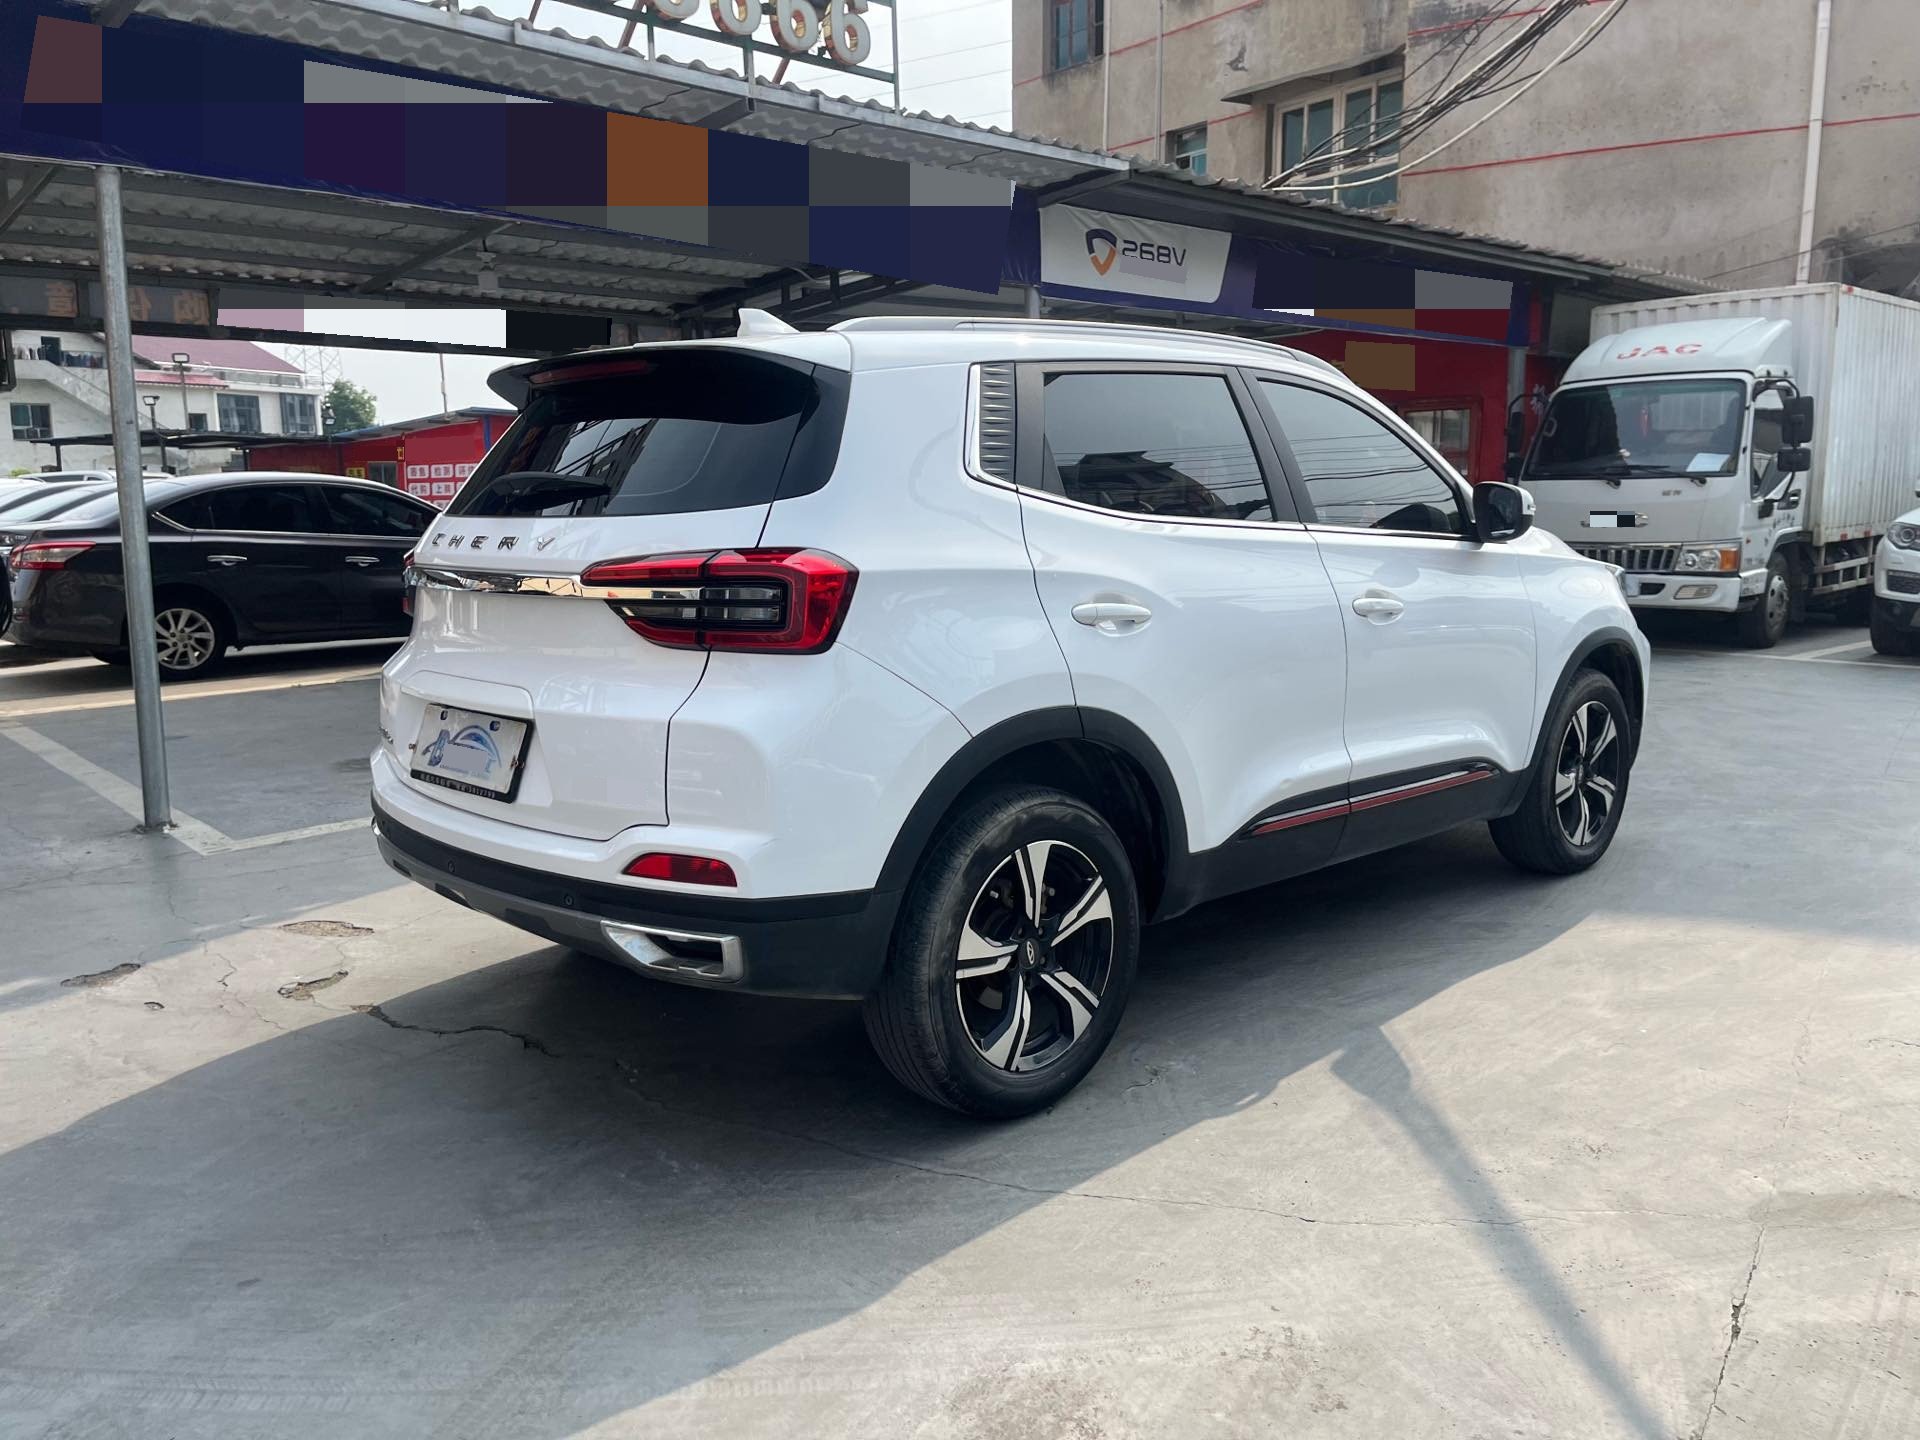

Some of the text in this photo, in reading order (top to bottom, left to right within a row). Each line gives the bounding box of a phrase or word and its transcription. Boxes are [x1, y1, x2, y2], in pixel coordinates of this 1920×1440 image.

[1122, 239, 1187, 267] 268V
[1616, 343, 1703, 360] JAC
[432, 533, 555, 551] CHERY
